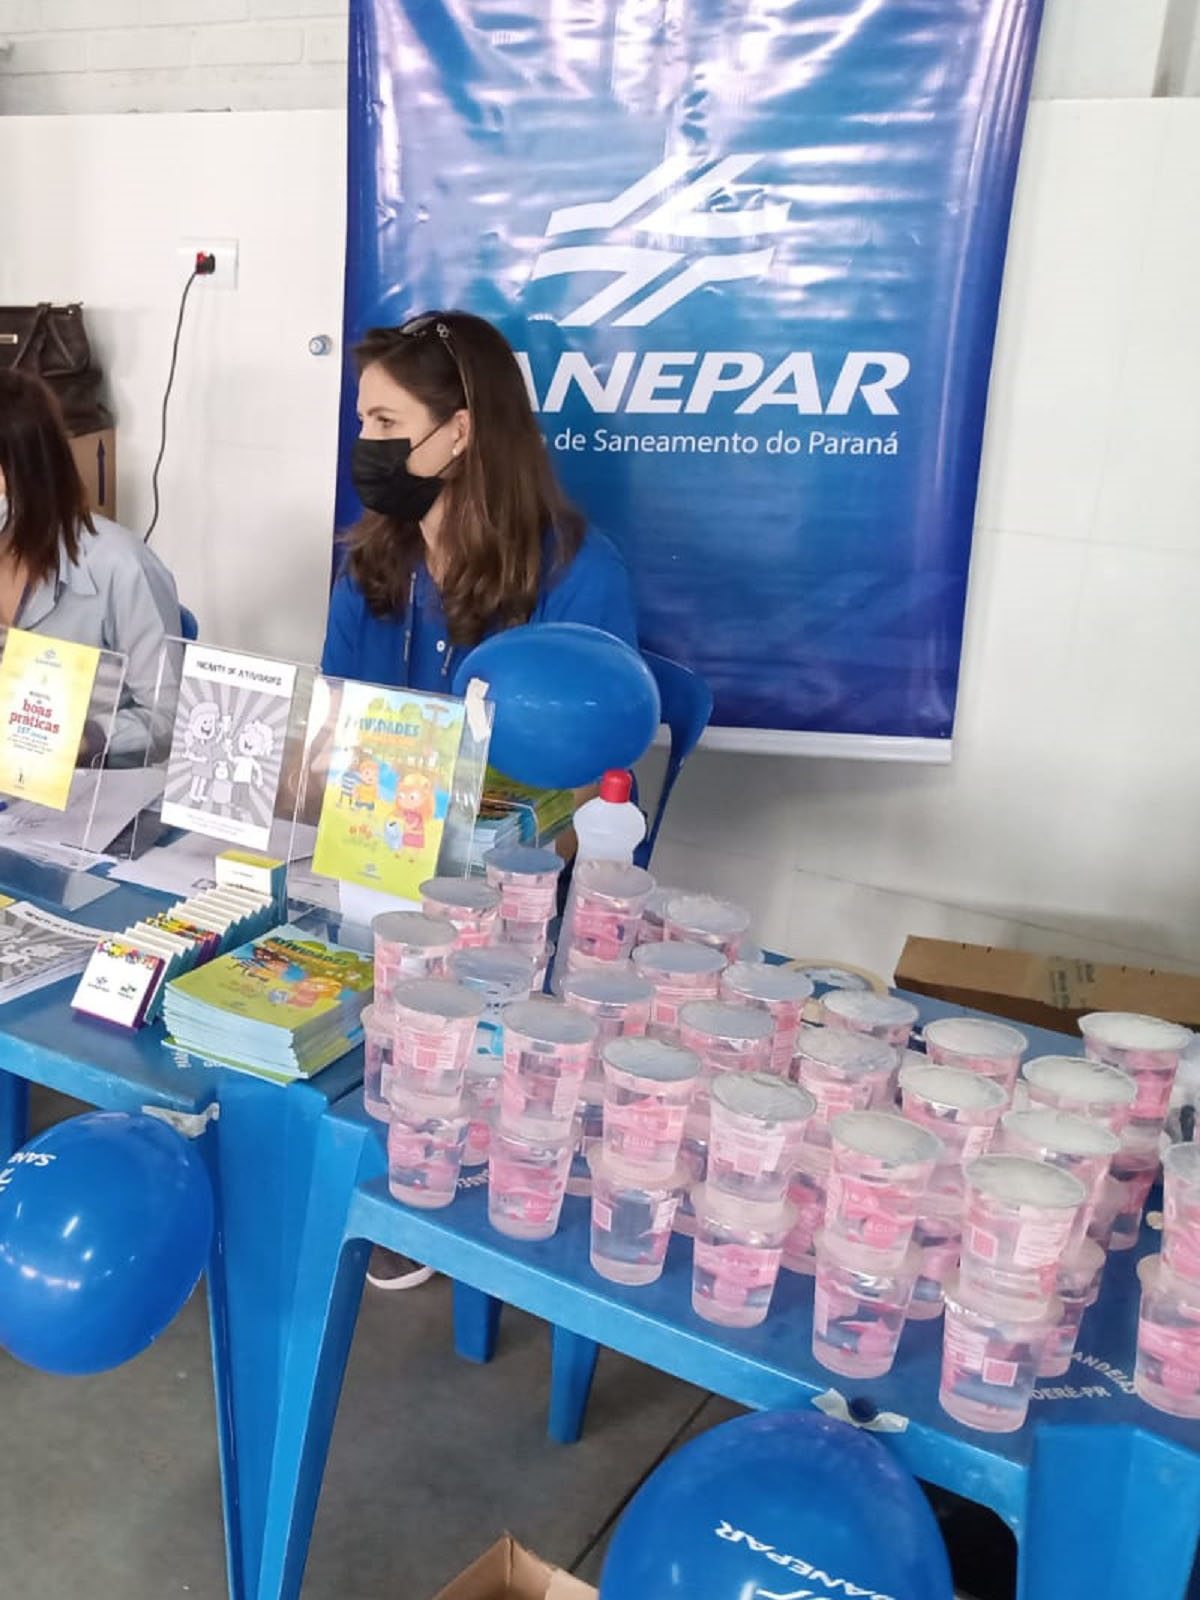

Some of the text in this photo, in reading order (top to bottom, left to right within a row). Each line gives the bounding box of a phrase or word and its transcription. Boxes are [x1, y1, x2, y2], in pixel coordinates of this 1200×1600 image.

[513, 351, 910, 415] NEPAR
[554, 429, 587, 452] de
[594, 430, 758, 454] Saneamento
[766, 430, 800, 455] do
[808, 430, 899, 456] Paraná
[23, 699, 53, 718] boas
